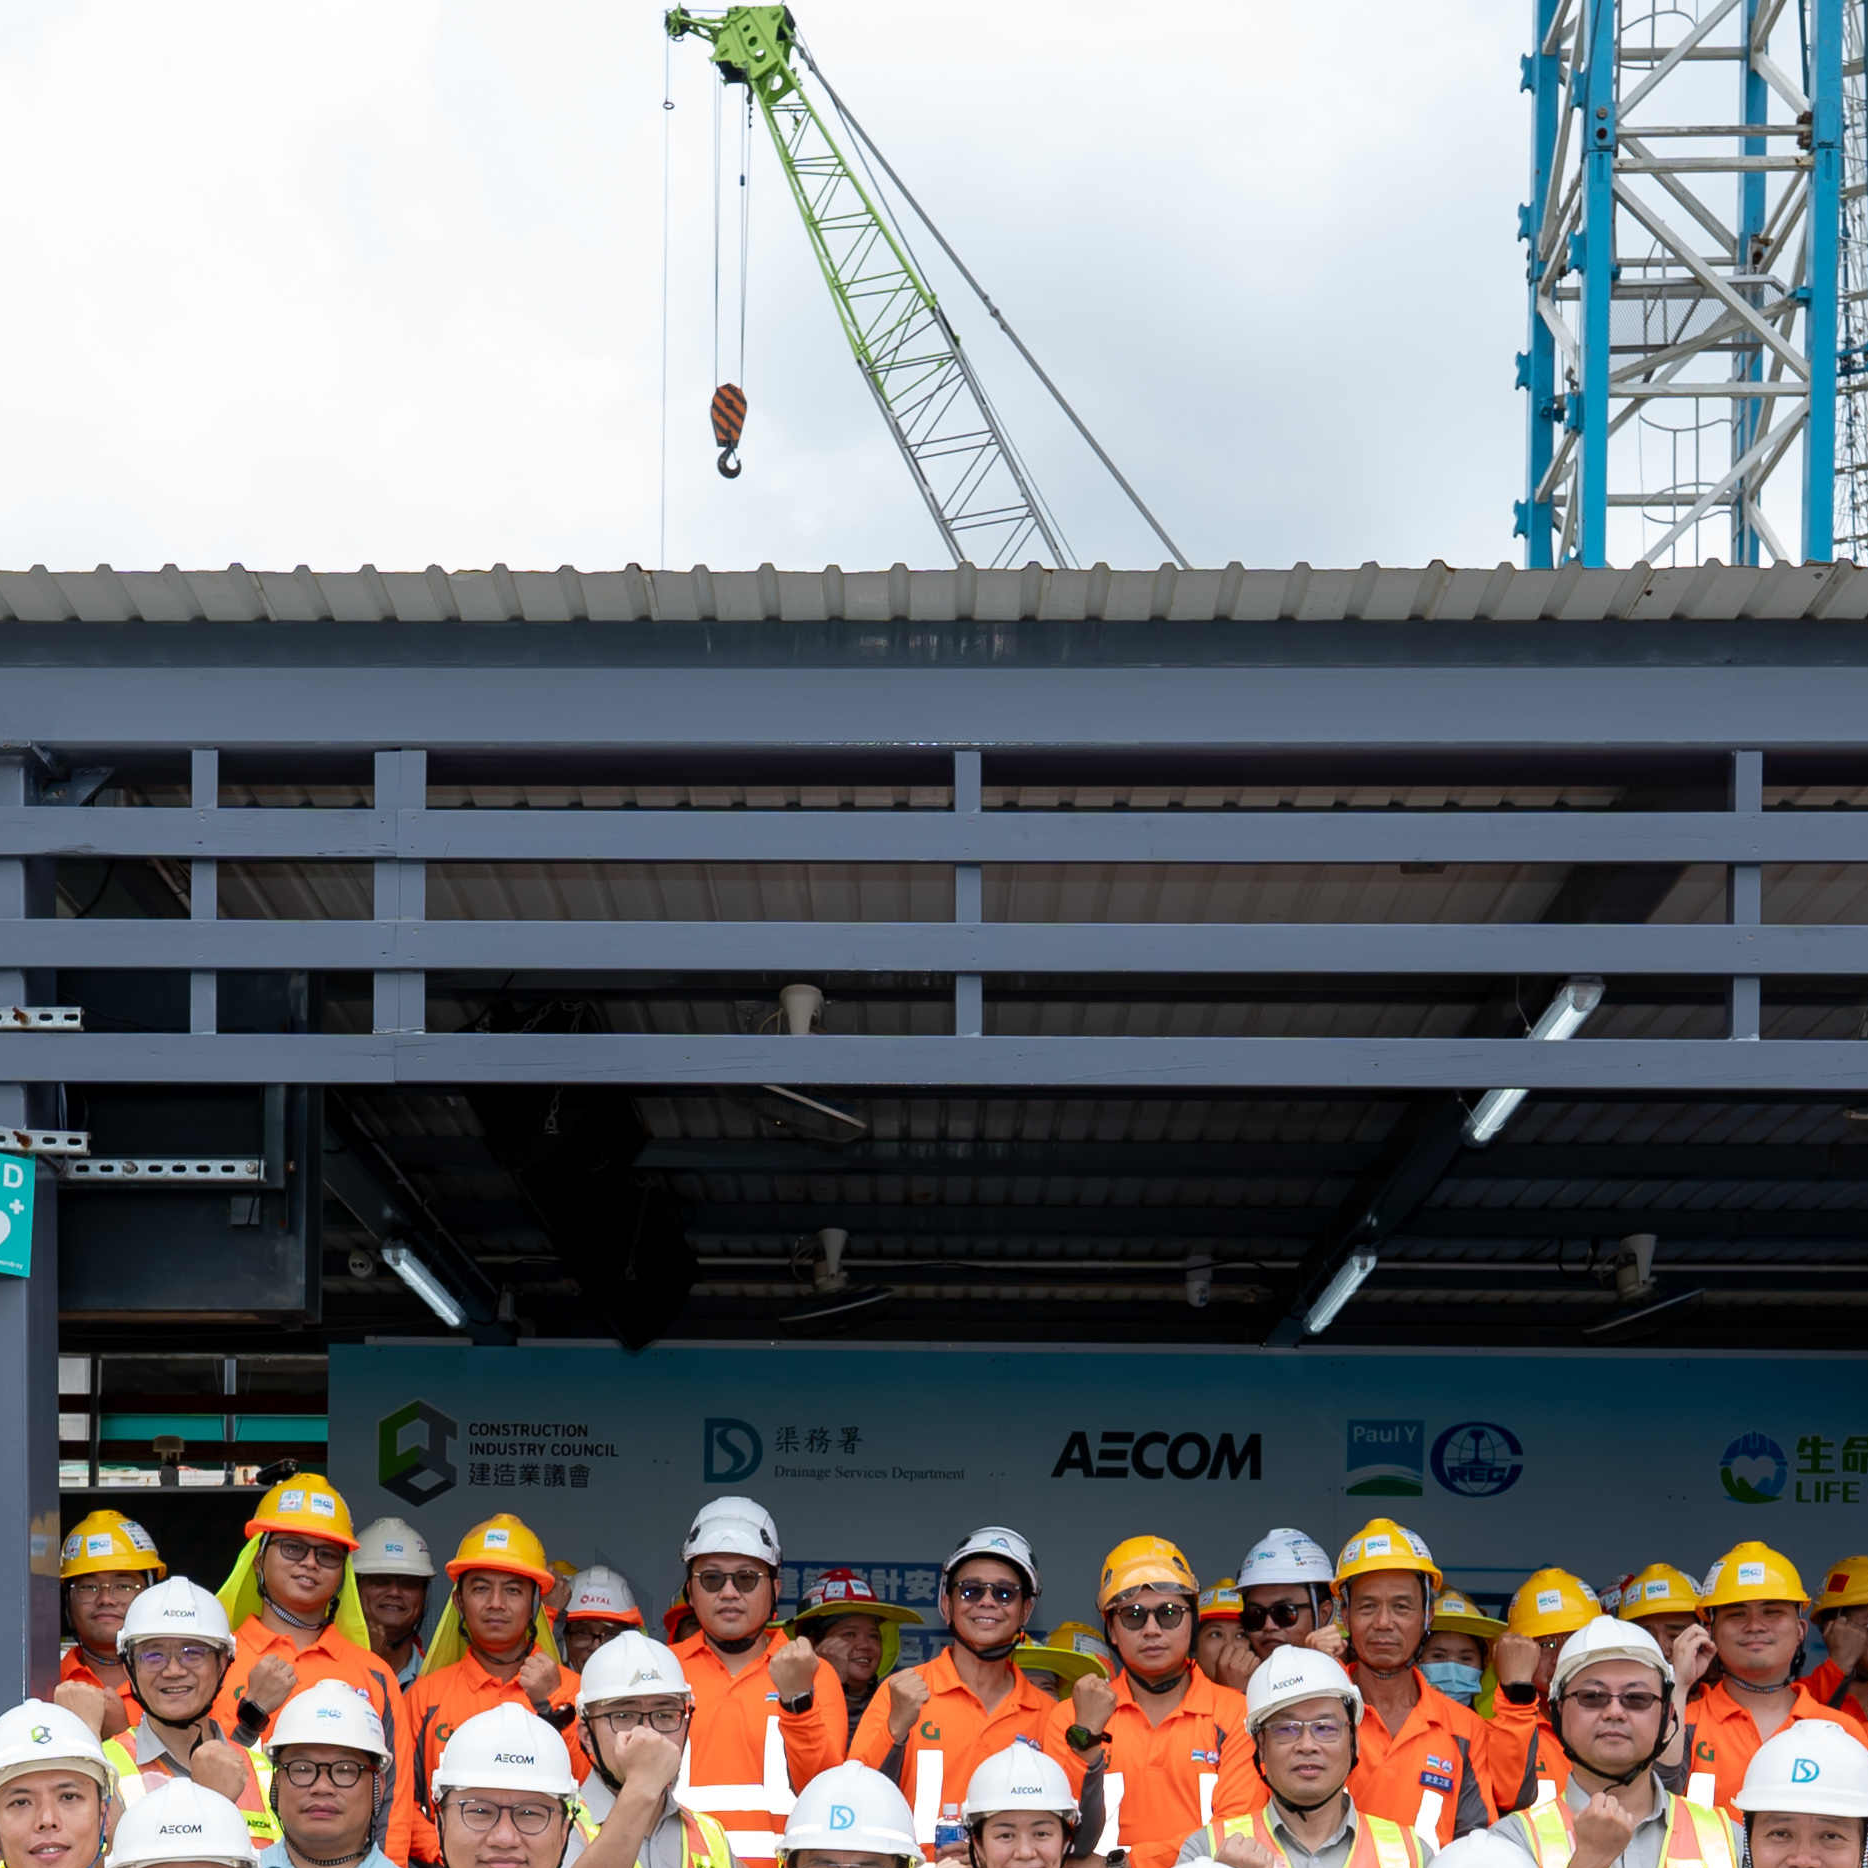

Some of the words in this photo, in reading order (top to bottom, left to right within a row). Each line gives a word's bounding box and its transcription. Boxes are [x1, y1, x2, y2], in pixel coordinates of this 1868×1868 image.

[468, 1423, 588, 1438] CONSTRUCTION
[1353, 1426, 1399, 1443] Paul
[1404, 1426, 1418, 1443] Y
[774, 1426, 863, 1455] 渠務署
[469, 1442, 546, 1457] INDUSTRY
[551, 1443, 619, 1458] COUNCIL
[1051, 1431, 1261, 1481] AECOM
[468, 1462, 591, 1488] 建造業議會
[774, 1464, 831, 1481] Drainage
[835, 1465, 887, 1479] Services
[891, 1466, 965, 1482] Department
[1795, 1480, 1865, 1503] LIFE
[589, 1595, 612, 1606] ATAL
[163, 1609, 196, 1618] AECOM
[1272, 1676, 1304, 1691] AECOM
[494, 1753, 535, 1766] AECOM
[1011, 1786, 1043, 1795] AECOM
[159, 1823, 203, 1835] AECOM
